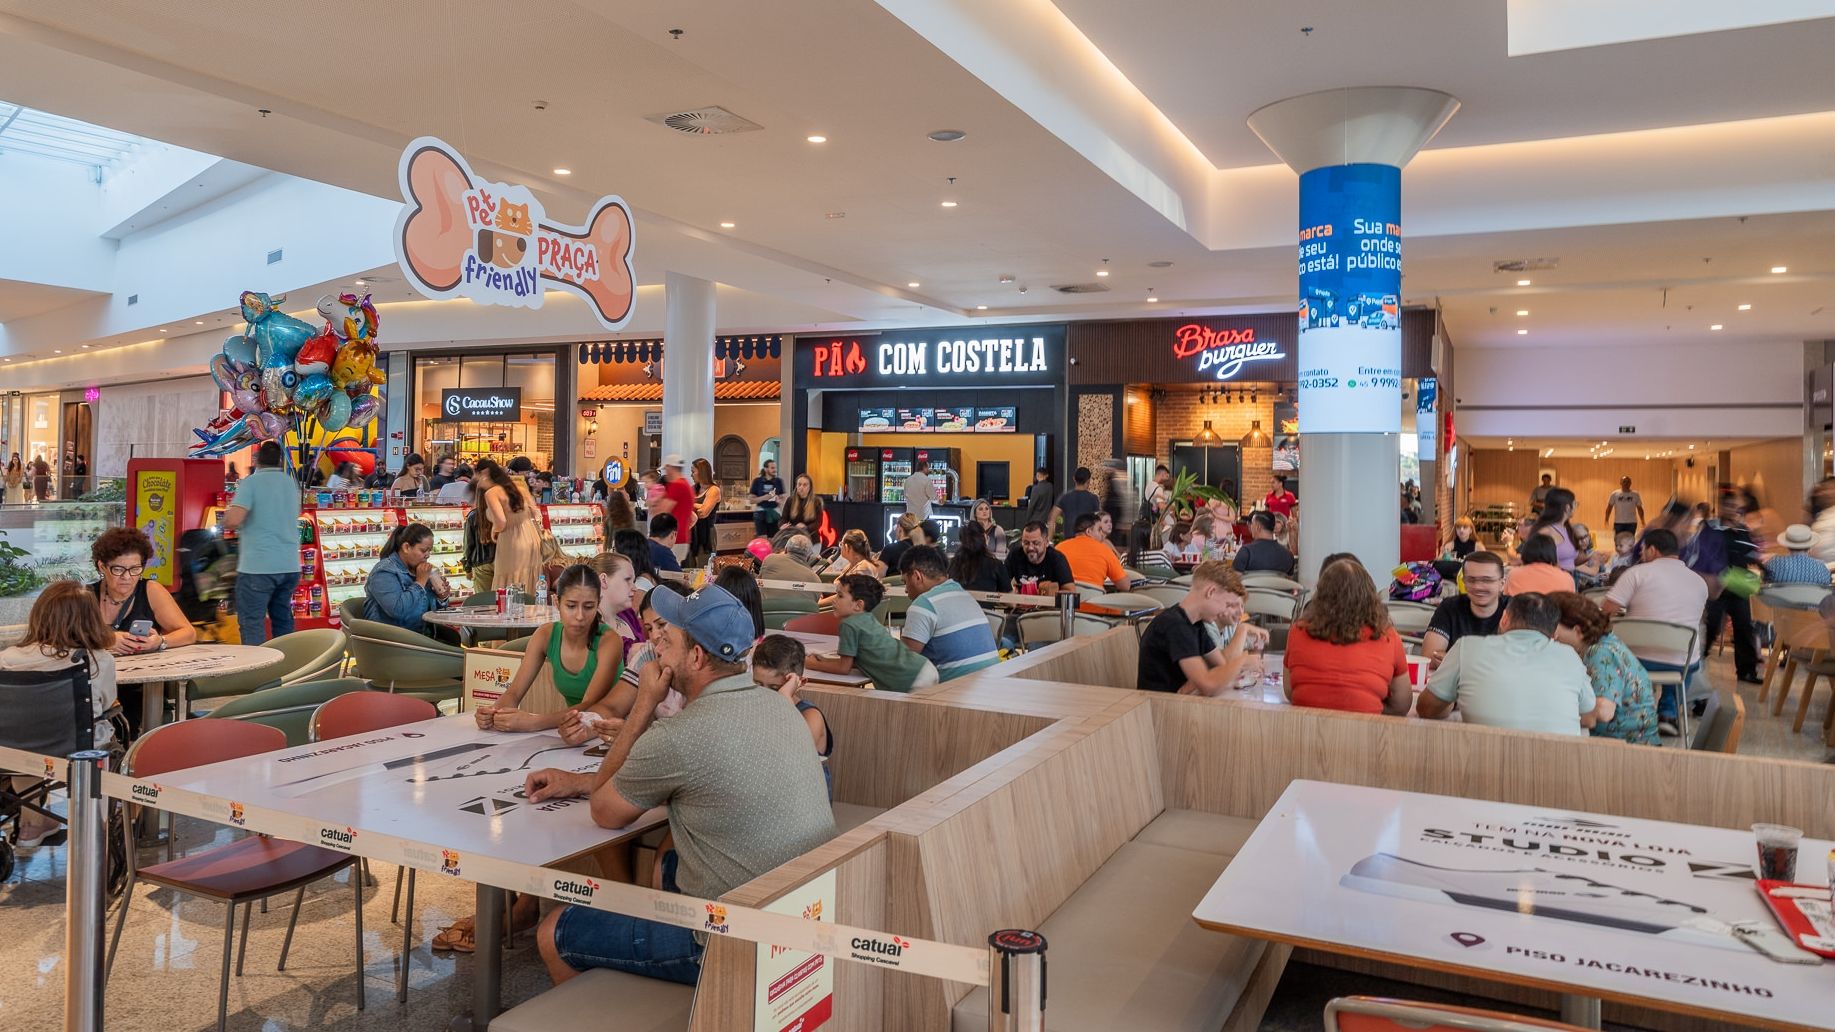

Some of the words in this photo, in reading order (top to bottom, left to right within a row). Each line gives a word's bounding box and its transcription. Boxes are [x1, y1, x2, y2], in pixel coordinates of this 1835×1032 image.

[467, 189, 496, 226] pet
[1354, 218, 1383, 235] Sua
[1305, 242, 1327, 257] seu
[1361, 236, 1394, 252] onde
[538, 237, 597, 278] PRAÇA
[1307, 253, 1339, 272] está!
[1347, 252, 1396, 272] público
[465, 254, 537, 297] friendly
[1174, 324, 1254, 358] Brasa
[879, 342, 927, 375] COM
[937, 337, 1047, 373] COSTELA
[1198, 342, 1285, 379] burguer
[1304, 368, 1328, 377] contato
[1358, 366, 1381, 375] Entre
[1371, 377, 1378, 387] 9
[474, 670, 496, 681] MESA
[1472, 822, 1517, 834] TEM
[1525, 829, 1555, 838] NA
[1563, 834, 1627, 848] NOVA
[1634, 843, 1693, 855] LOJA
[1423, 828, 1666, 867] STUDIO
[1687, 860, 1759, 881] Z
[851, 952, 876, 963] Shopping
[876, 957, 900, 966] Cascavel
[1506, 945, 1566, 963] PISO
[1574, 957, 1774, 998] JACAREZINHO
